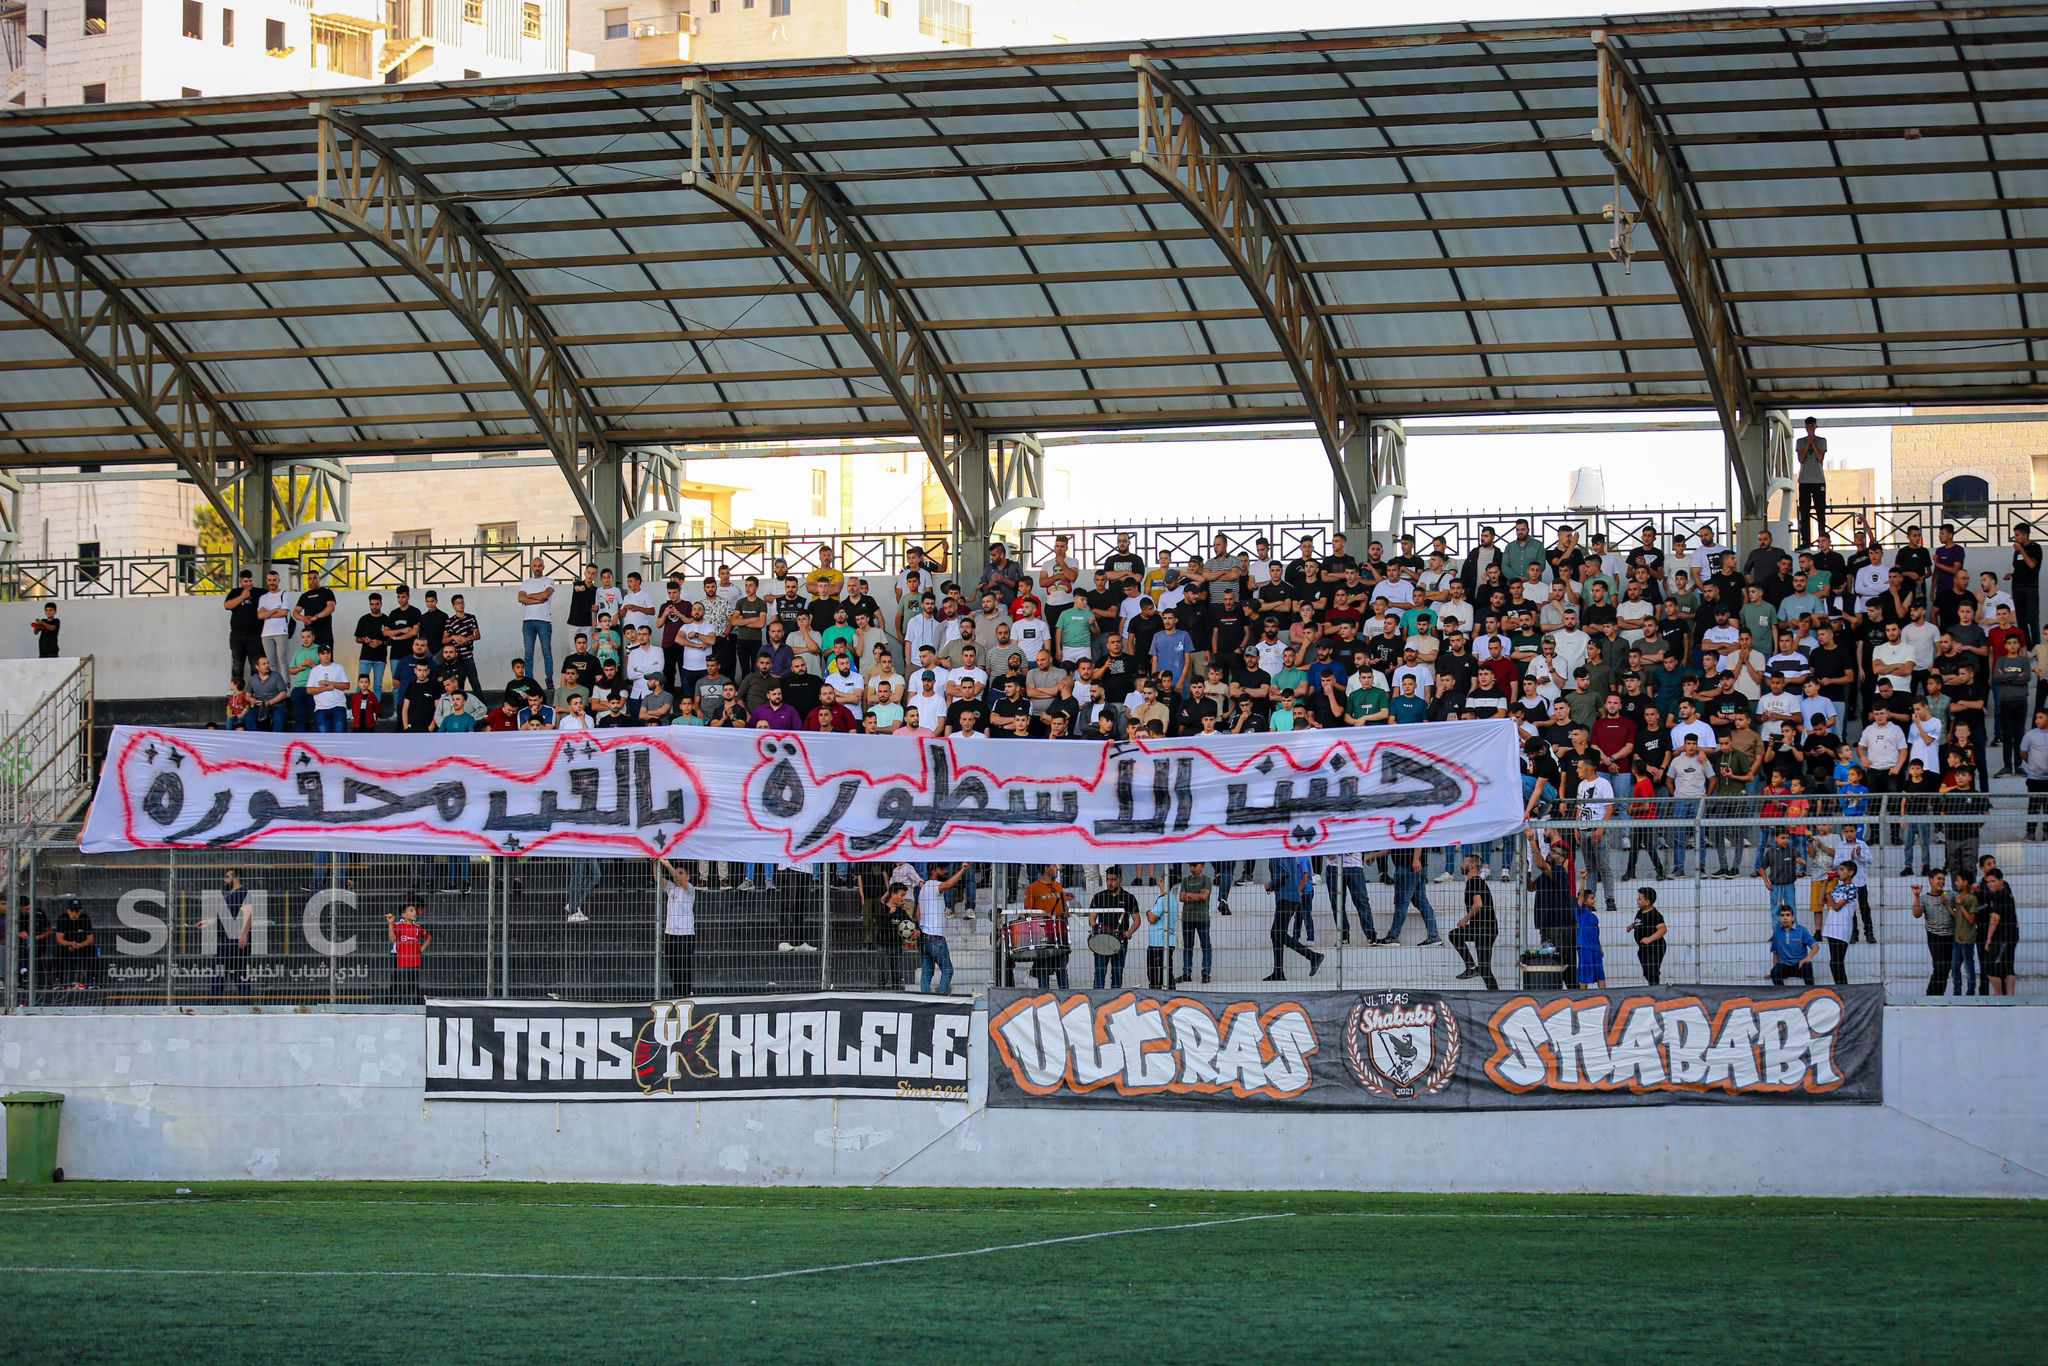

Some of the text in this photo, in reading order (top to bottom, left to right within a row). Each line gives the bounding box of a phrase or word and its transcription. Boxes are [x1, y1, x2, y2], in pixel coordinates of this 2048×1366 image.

[1225, 751, 1462, 843] جنين
[1363, 992, 1409, 1006] ULTRAS
[1360, 1003, 1437, 1033] Shababi
[427, 1016, 633, 1080] ULTRAS
[718, 1010, 970, 1080] KHALELE
[896, 1080, 933, 1098] Since
[1395, 1088, 1414, 1096] 2021
